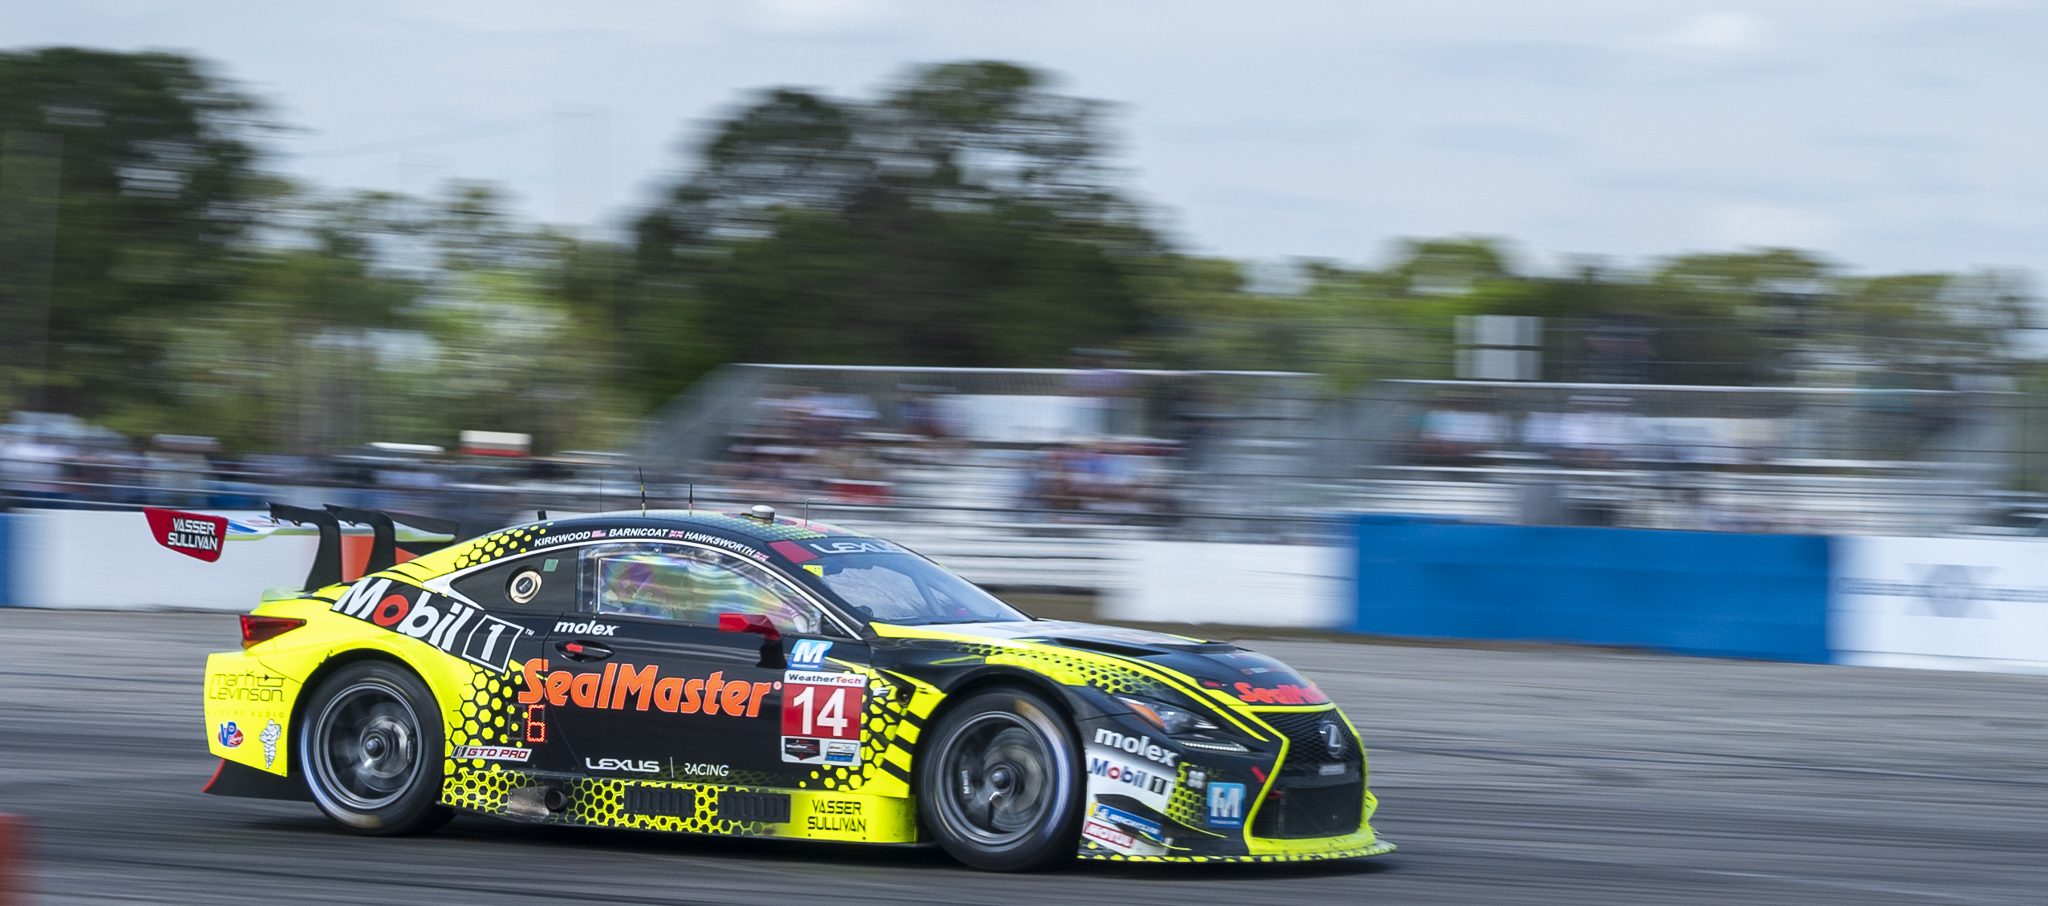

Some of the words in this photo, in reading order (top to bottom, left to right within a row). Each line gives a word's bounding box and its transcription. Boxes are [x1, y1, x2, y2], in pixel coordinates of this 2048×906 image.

[172, 517, 216, 536] VASSER
[167, 531, 219, 552] SULLIVAN
[534, 531, 591, 547] KIRKWOOD
[608, 528, 668, 538] BARNICOAT
[684, 531, 755, 556] HAWKSWORTH
[331, 576, 475, 652] Mobil
[553, 620, 619, 637] molex
[211, 669, 255, 687] mark
[789, 673, 862, 685] WeatherTech
[209, 686, 285, 703] Levinson
[793, 686, 848, 737] 14
[526, 704, 545, 742] 6
[466, 748, 498, 757] GTD
[499, 749, 529, 759] PRO
[1093, 727, 1179, 768] molex
[585, 757, 660, 773] LEXUS
[684, 763, 729, 777] RACING
[1088, 758, 1147, 788] Mobil
[811, 799, 862, 816] VASSER
[807, 815, 867, 833] SULLIVAN
